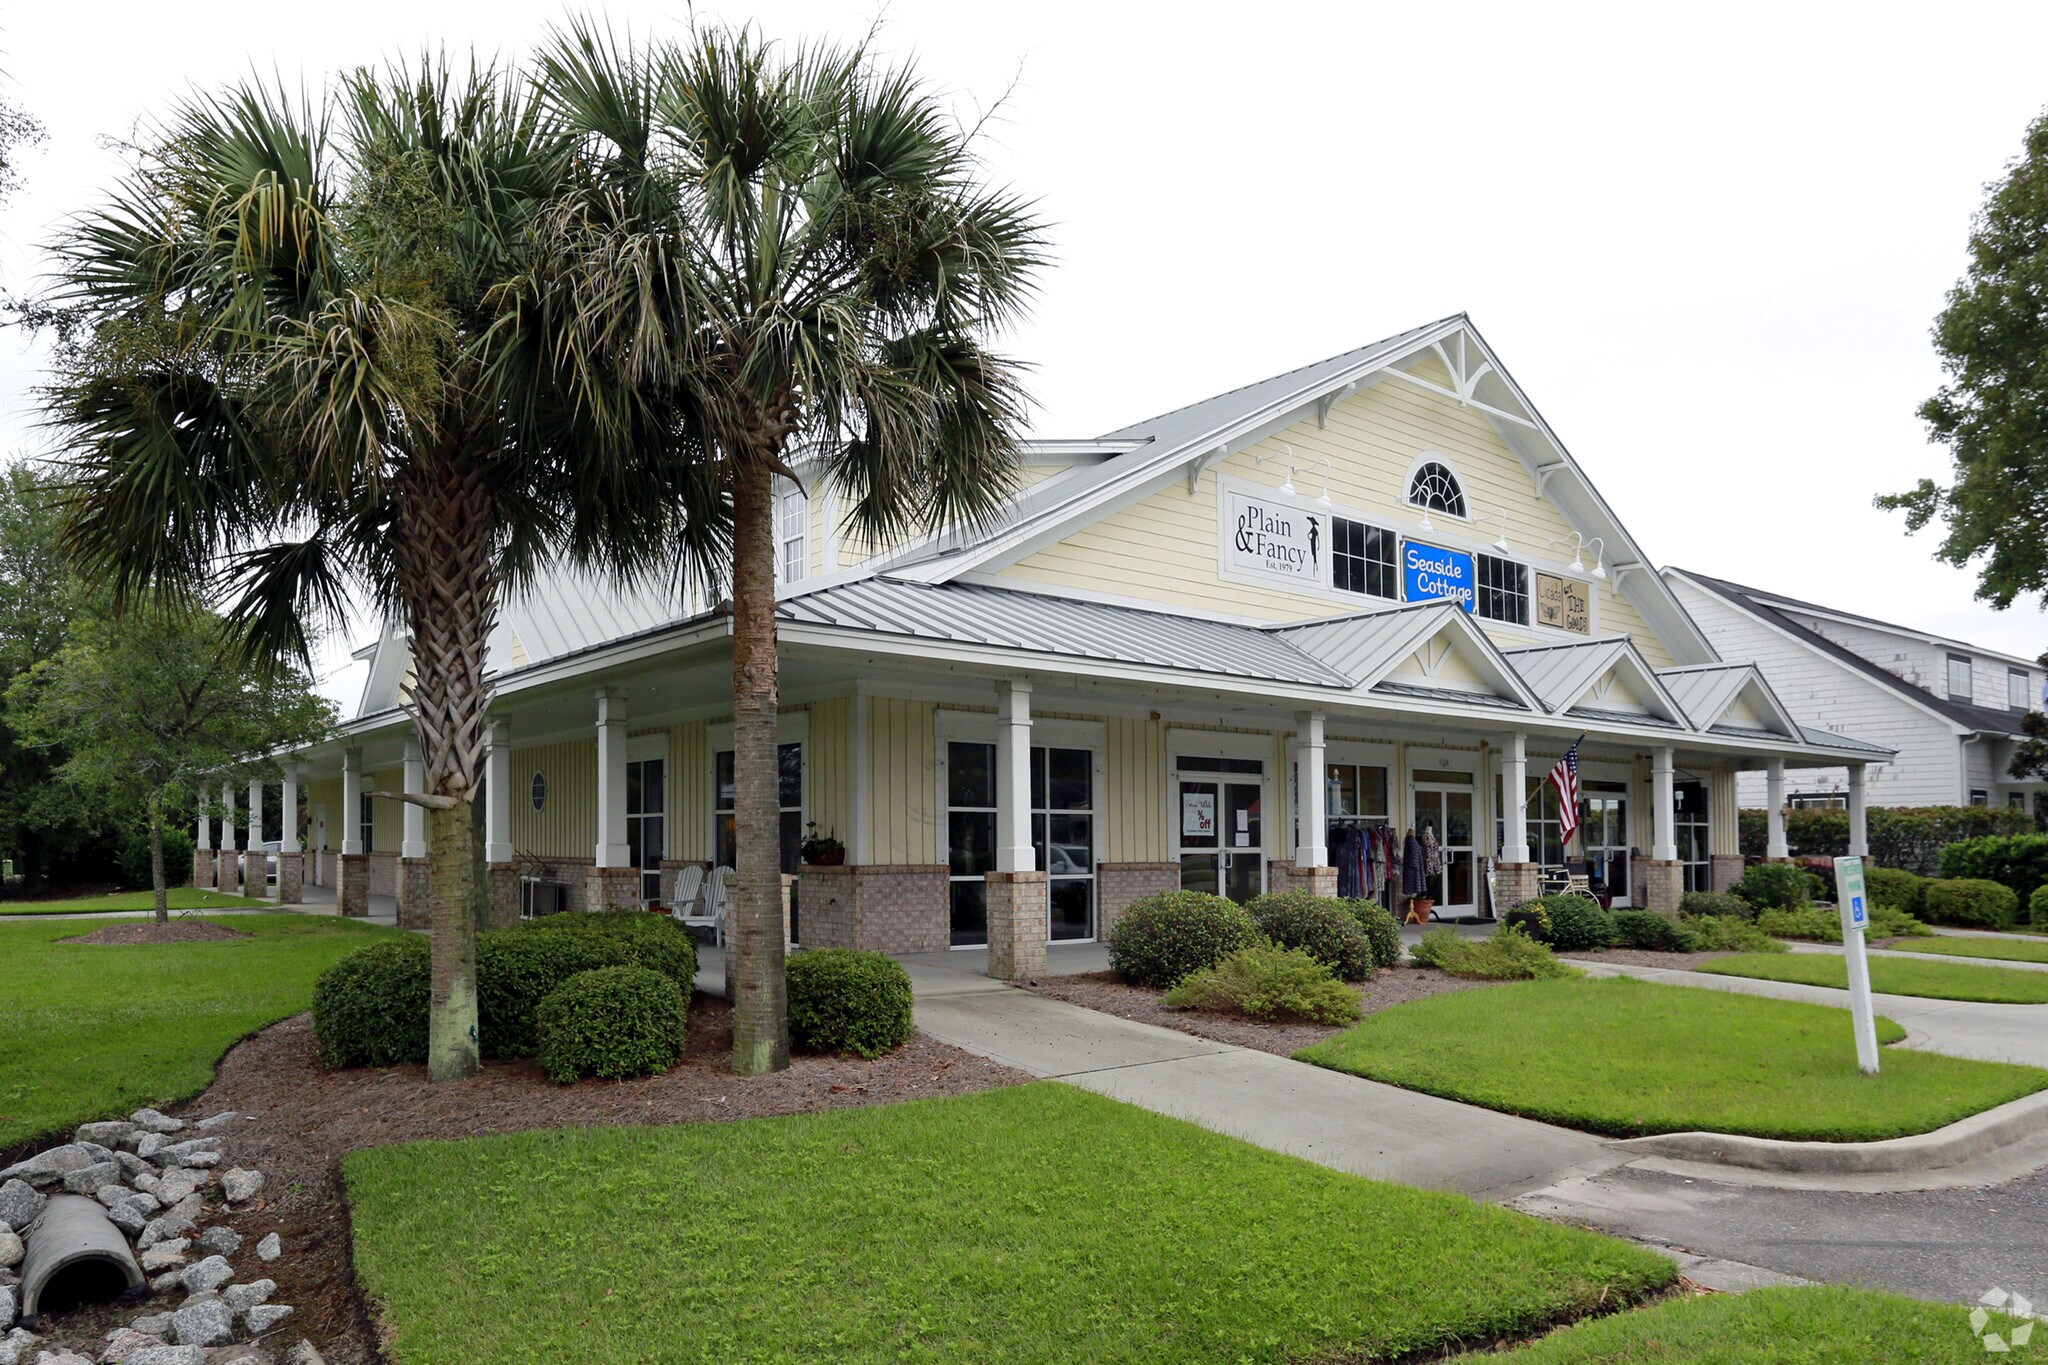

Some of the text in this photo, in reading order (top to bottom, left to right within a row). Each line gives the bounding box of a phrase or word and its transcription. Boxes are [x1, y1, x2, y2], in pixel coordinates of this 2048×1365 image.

[1247, 505, 1292, 538] Plain
[1235, 514, 1307, 572] & Fancy
[1266, 559, 1292, 572] Est. 1979
[1407, 549, 1462, 579] Seaside
[1417, 572, 1473, 606] Cottage
[1567, 595, 1585, 613] THE
[1200, 819, 1211, 829] off
